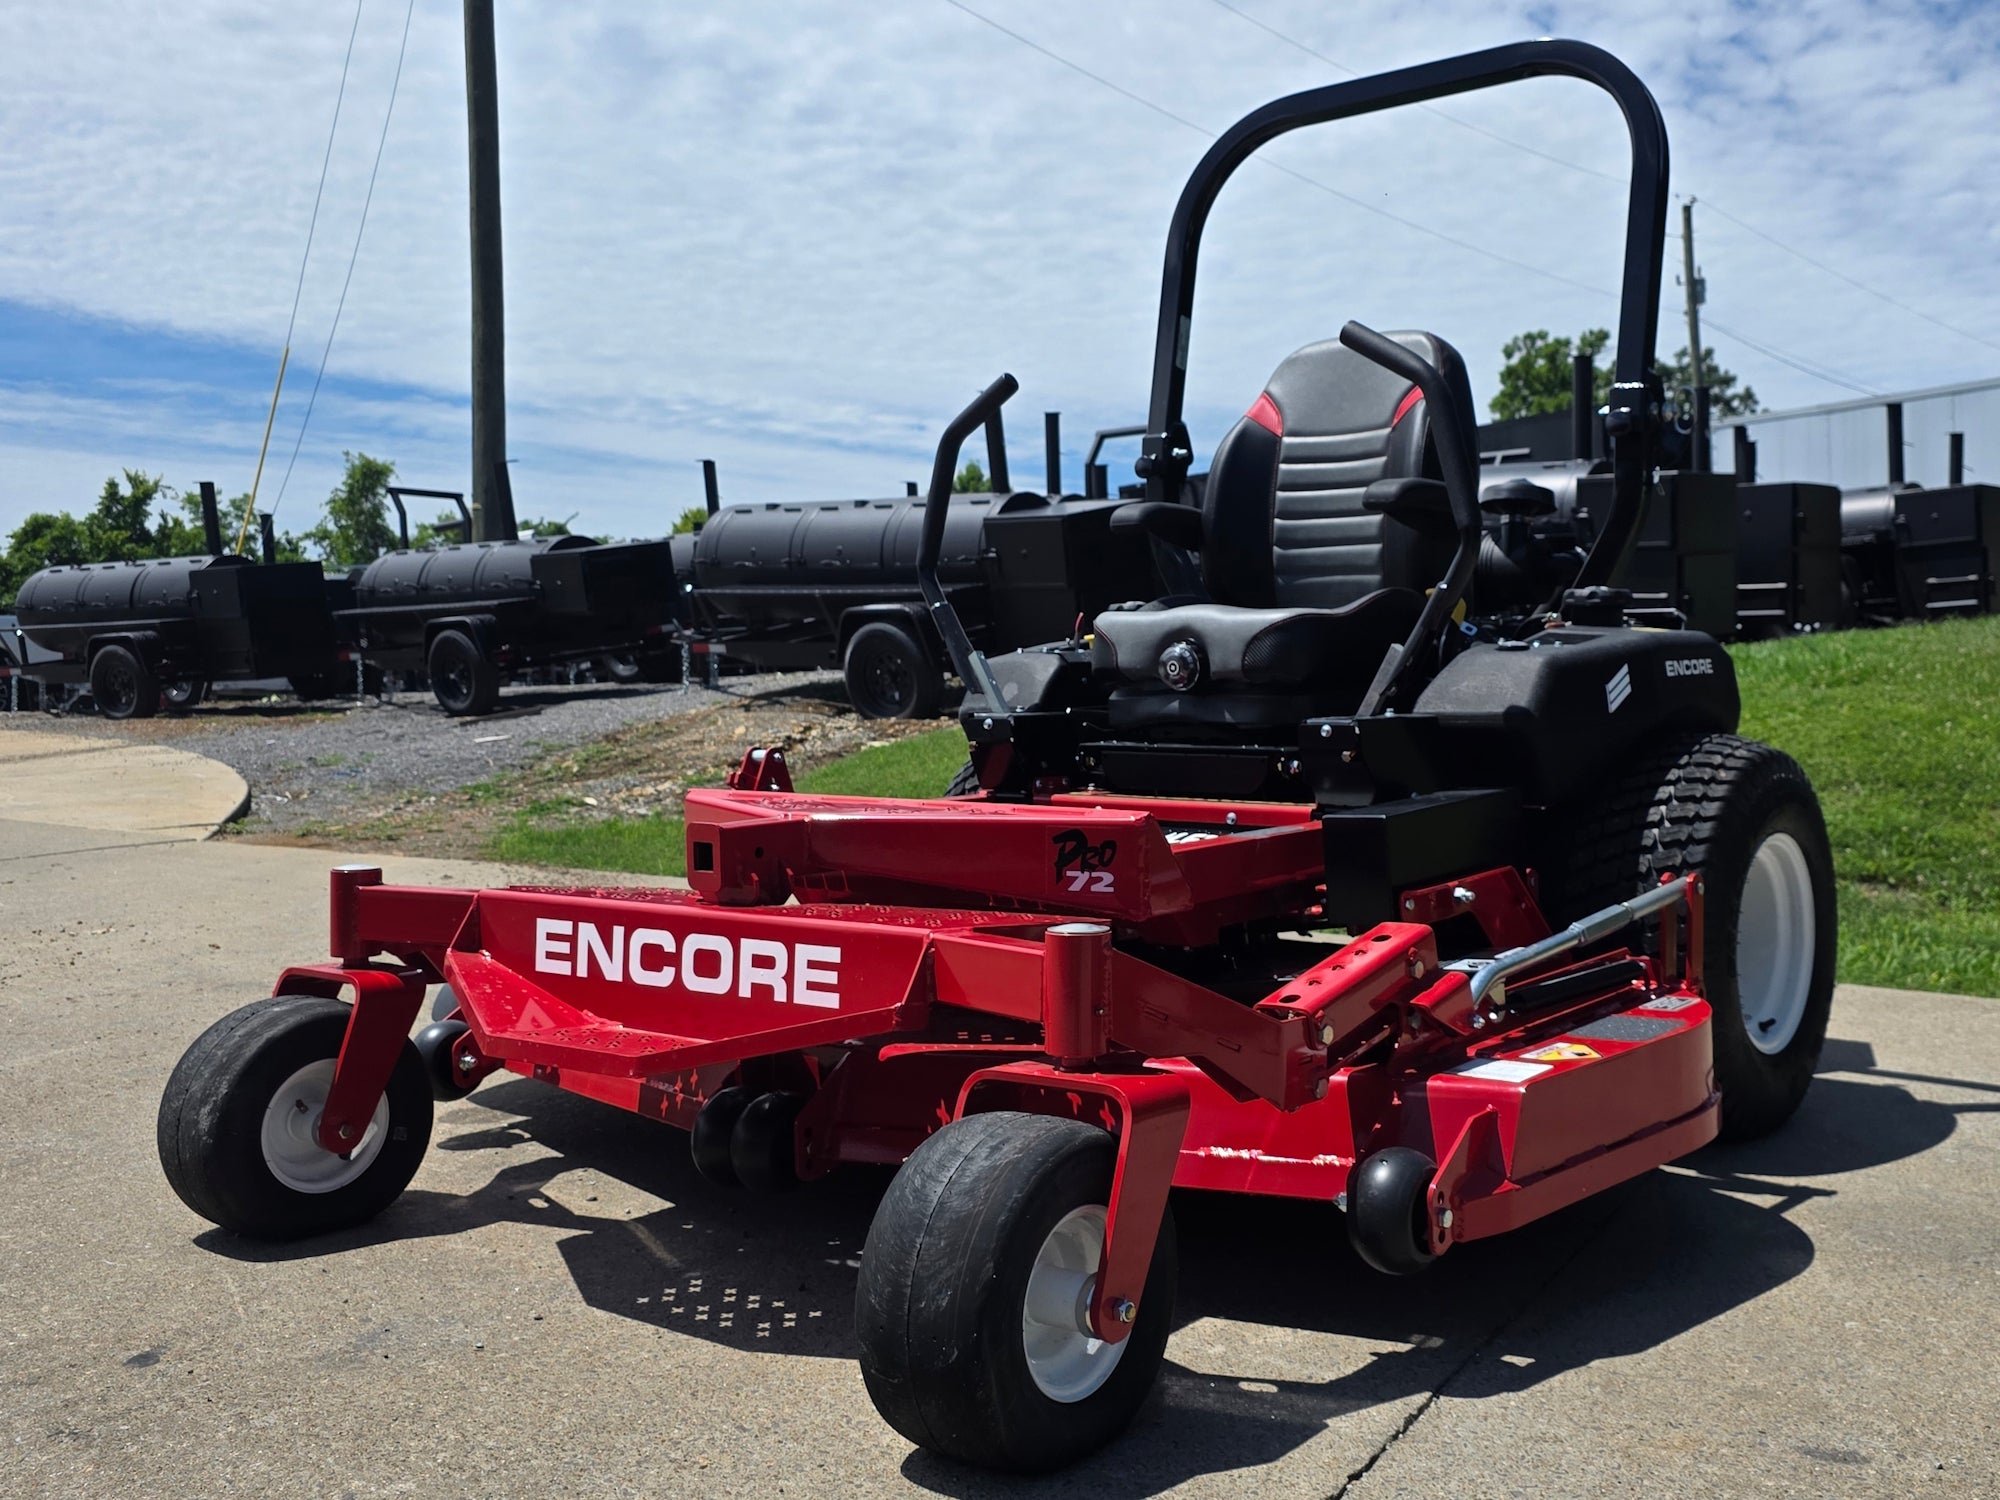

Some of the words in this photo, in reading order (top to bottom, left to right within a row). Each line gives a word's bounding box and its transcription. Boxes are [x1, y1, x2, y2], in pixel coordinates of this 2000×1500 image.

[1665, 658, 1714, 677] ENCORE
[1066, 870, 1115, 893] 72
[535, 917, 841, 1009] ENCORE
